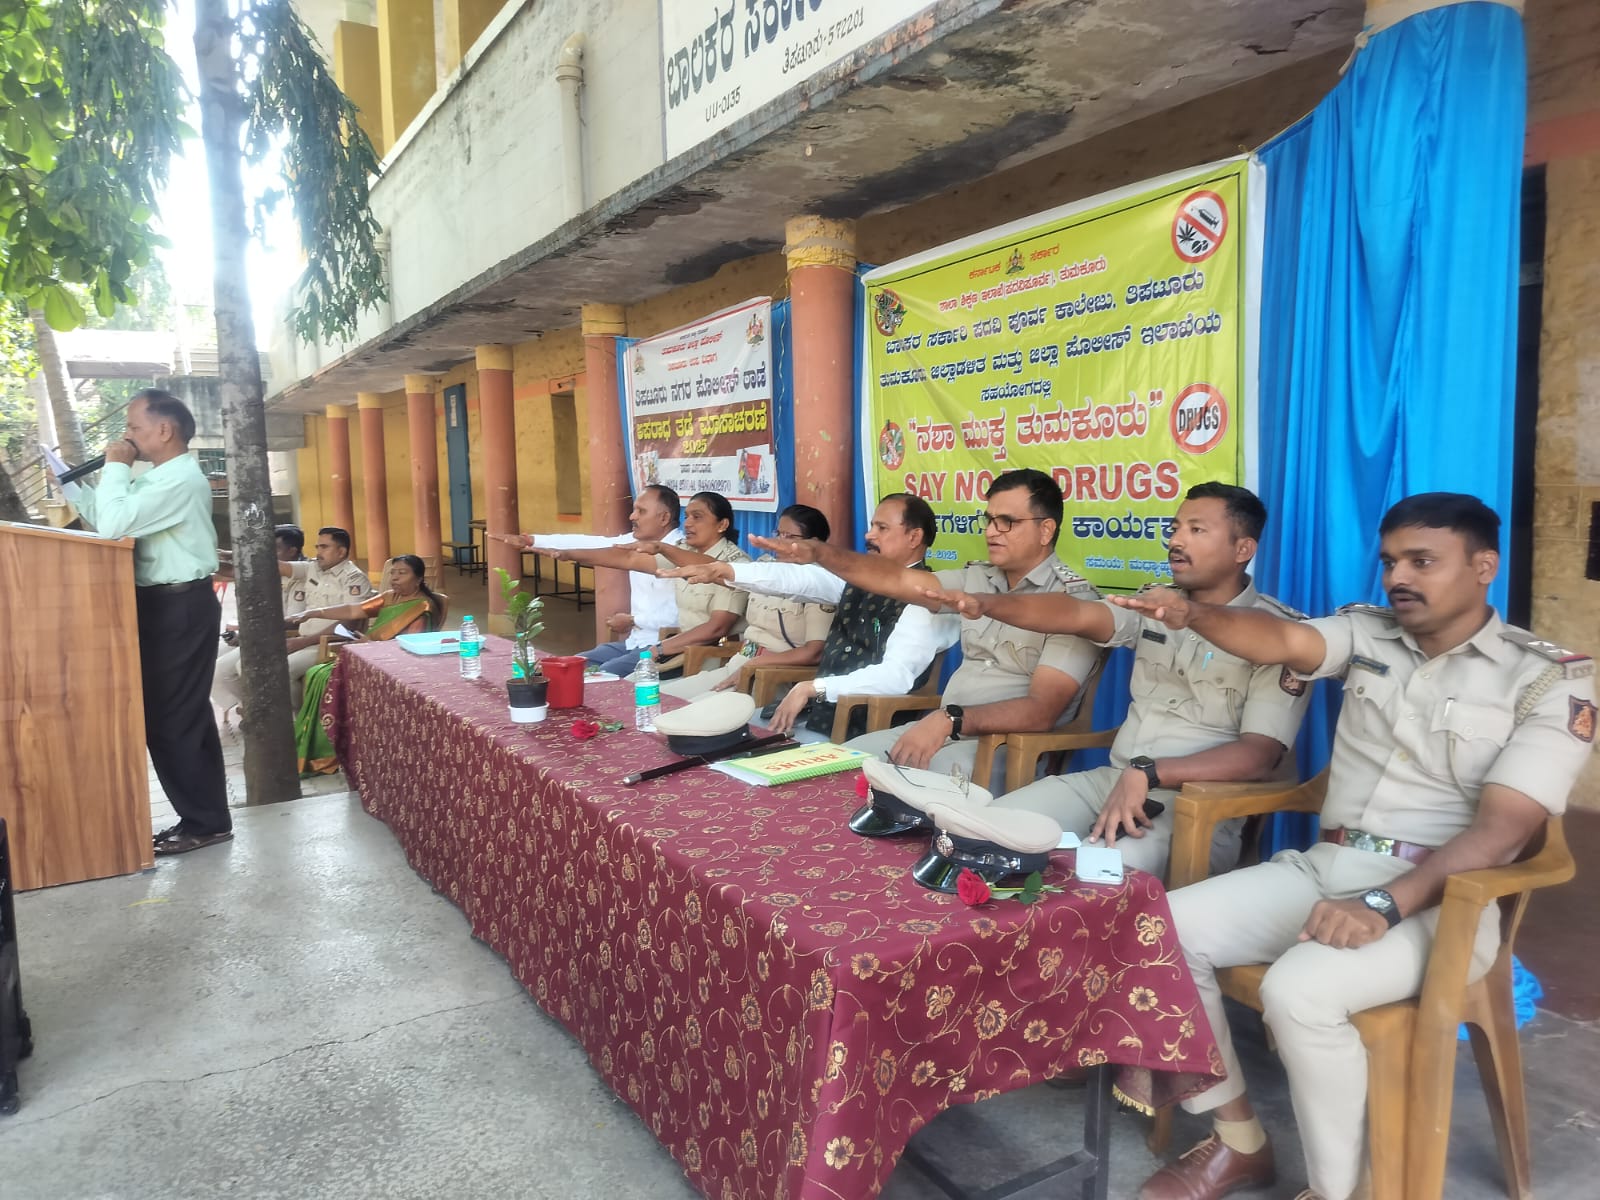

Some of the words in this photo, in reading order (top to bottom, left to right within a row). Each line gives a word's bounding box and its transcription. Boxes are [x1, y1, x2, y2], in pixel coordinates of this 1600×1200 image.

[1060, 254, 1107, 281] ತುಮಕೂರು
[927, 325, 968, 347] ಸರ್ಕಾರಿ
[973, 316, 1002, 338] ಪದವಿ
[1008, 307, 1048, 333] ಪೂರ್ವ
[1125, 268, 1205, 305] ತಿಪಟೂರು
[992, 347, 1023, 374] ಮತ್ತು
[1029, 343, 1059, 367] ಜಿಲ್ಲಾ
[1140, 310, 1222, 345] ಇಲಾಖೆಯ
[981, 378, 1052, 401] ಸಹಯೋಗದಲ್ಲಿ
[960, 408, 1007, 461] ಮುಕ್ತ
[1178, 400, 1219, 432] DRUGS
[905, 472, 947, 502] SAY
[955, 469, 994, 502] NO
[1052, 461, 1180, 500] DRUGS
